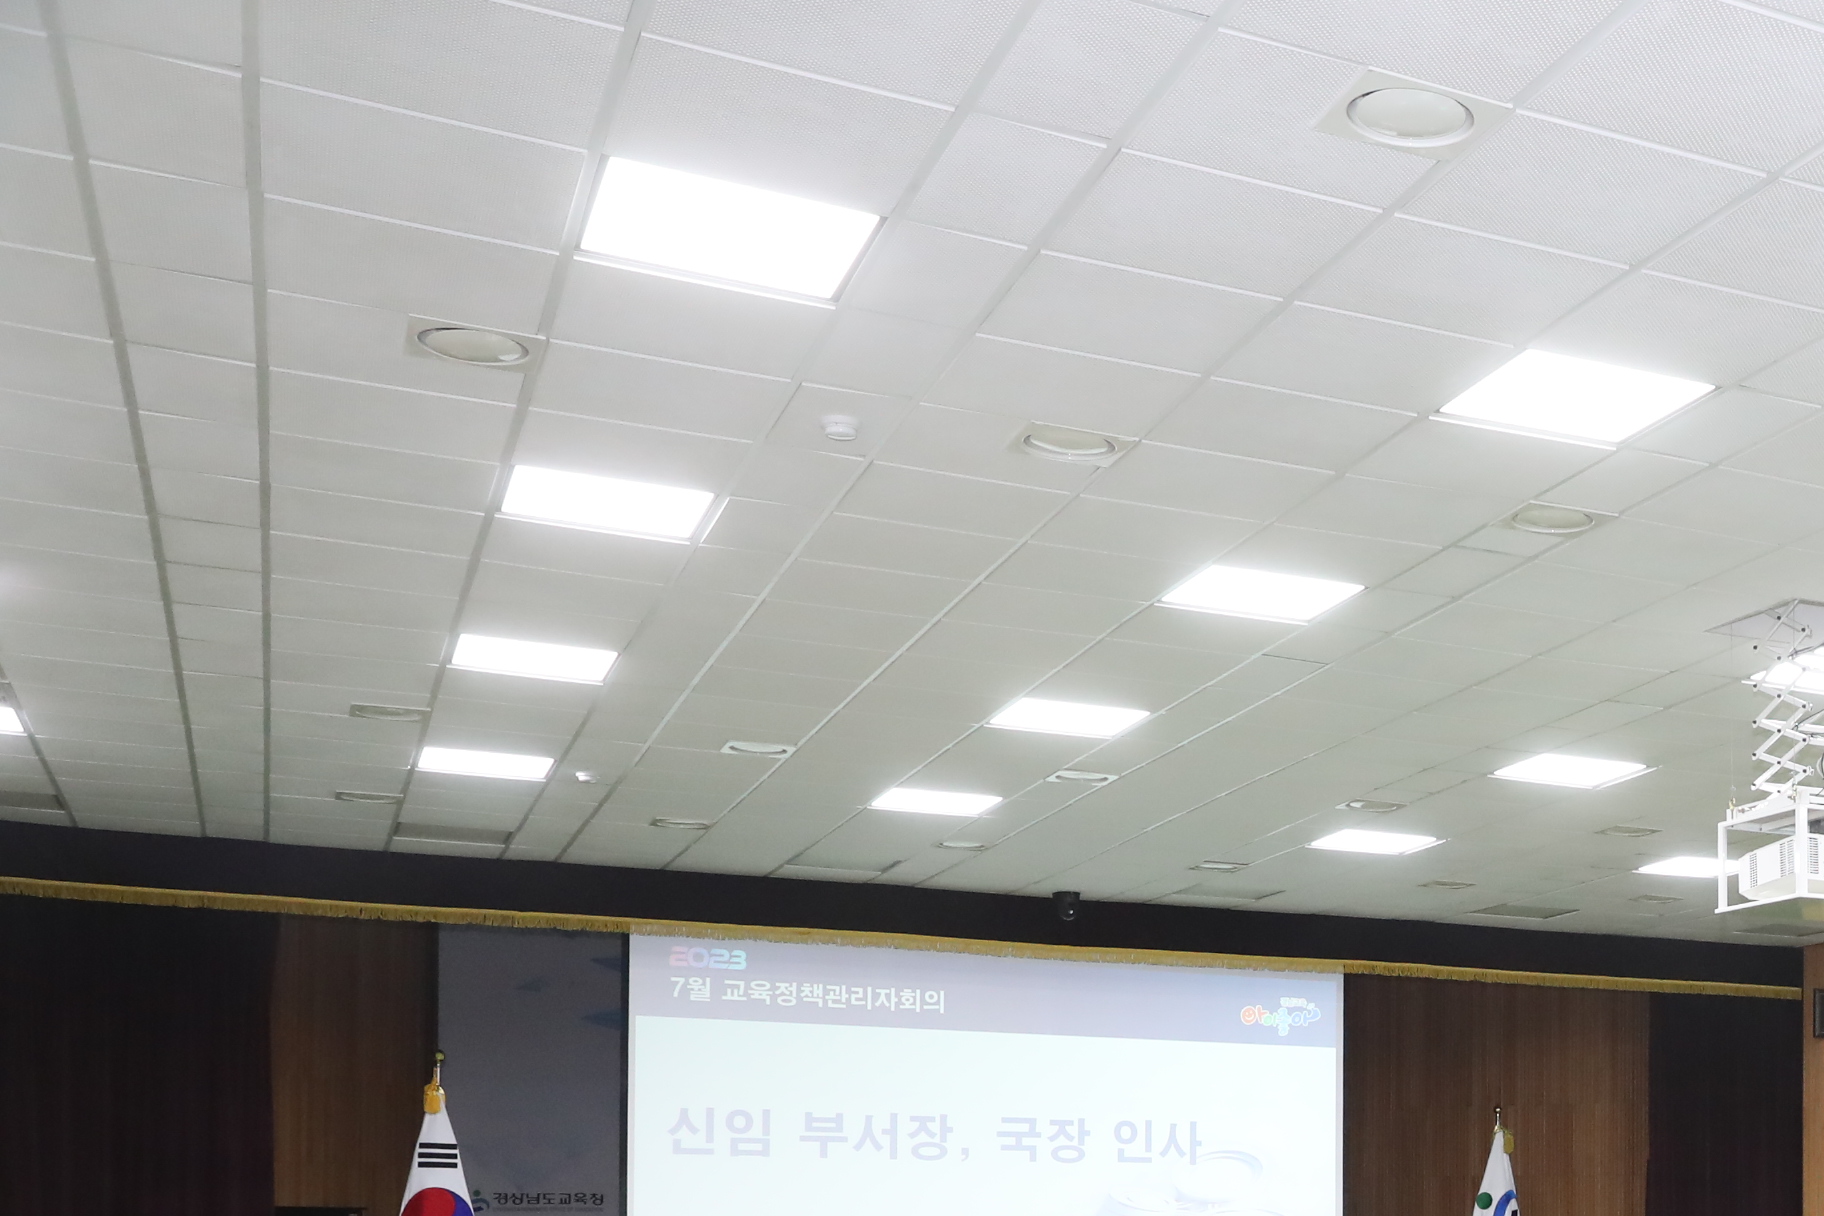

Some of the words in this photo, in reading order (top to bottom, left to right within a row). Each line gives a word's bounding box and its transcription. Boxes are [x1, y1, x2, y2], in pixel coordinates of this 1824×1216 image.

[669, 946, 747, 970] 2023
[670, 976, 711, 1002] 7월
[721, 978, 945, 1014] 교육정책관리자회의
[667, 1107, 771, 1158] 신임
[799, 1112, 969, 1162] 부서장,
[996, 1116, 1091, 1164] 국장
[1113, 1119, 1202, 1166] 인사
[492, 1192, 604, 1206] 경상남도교육청
